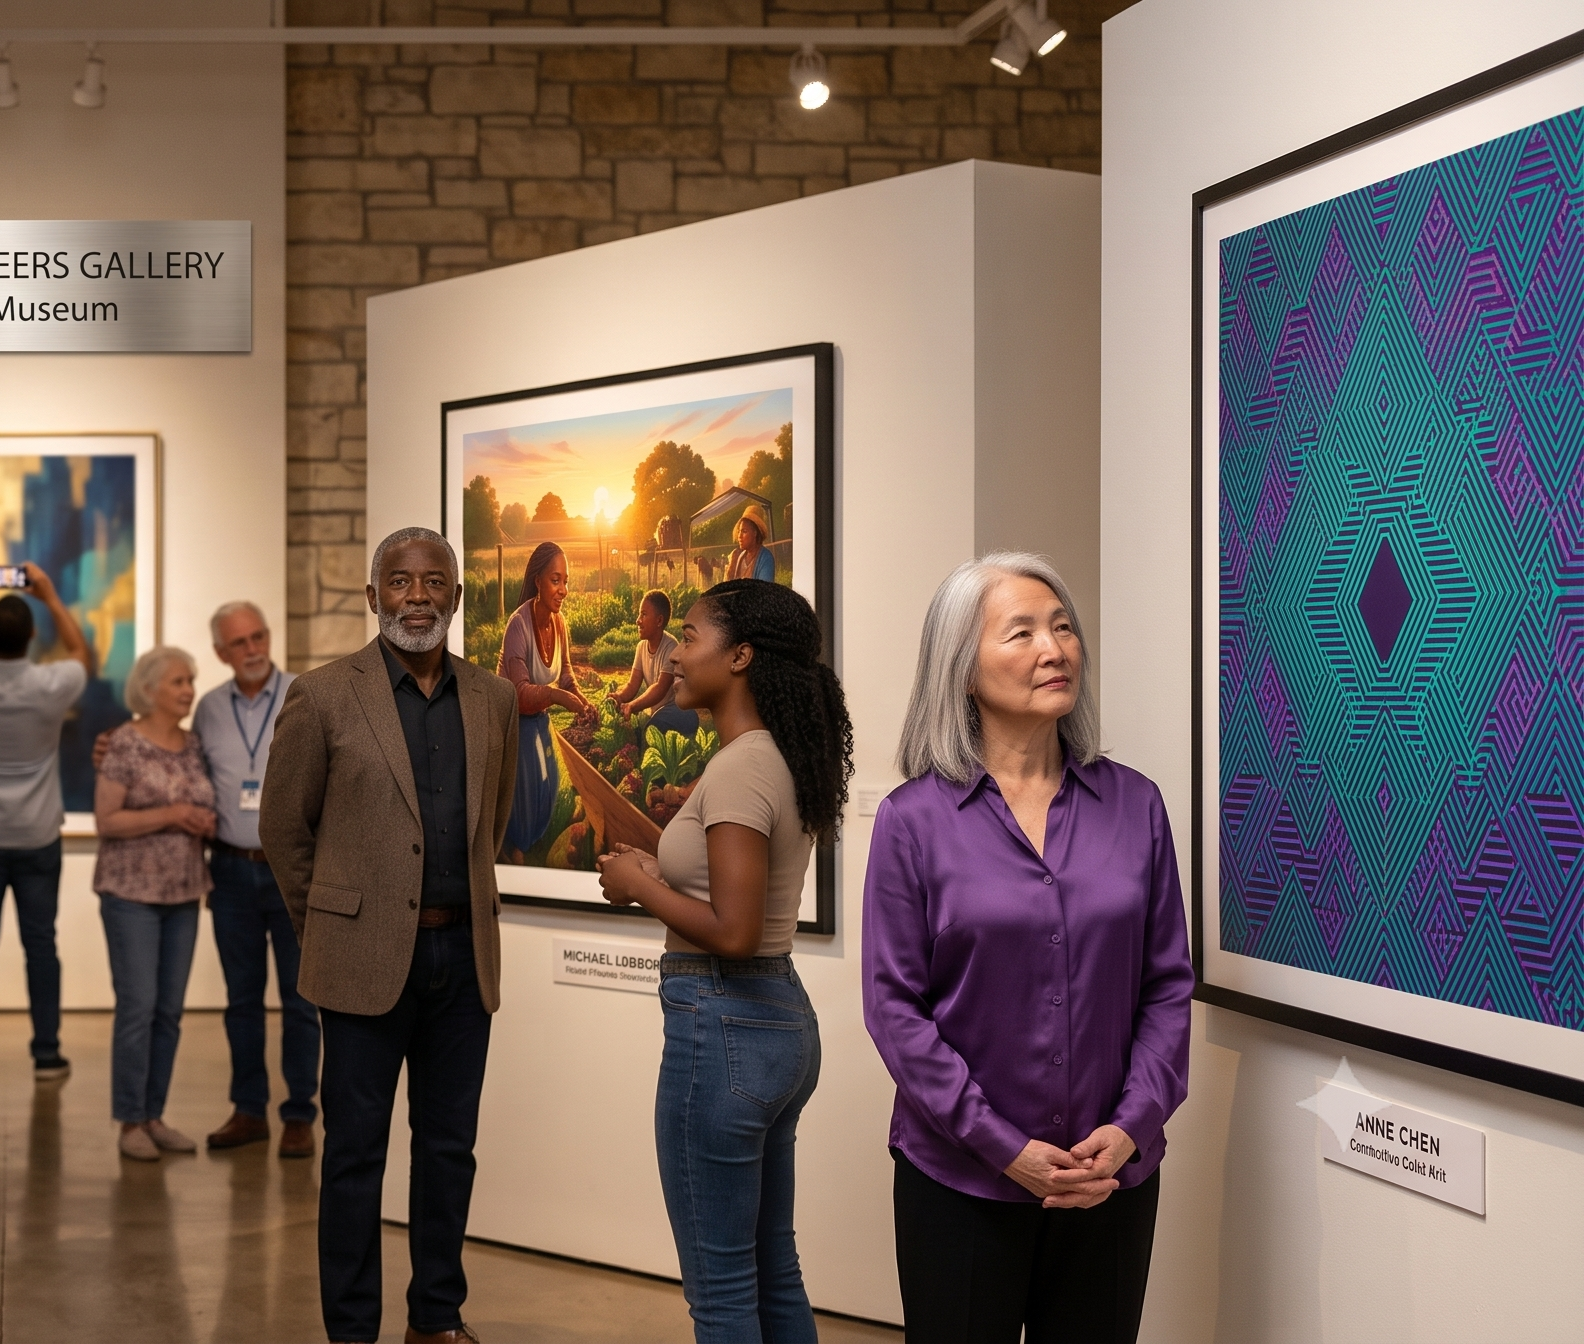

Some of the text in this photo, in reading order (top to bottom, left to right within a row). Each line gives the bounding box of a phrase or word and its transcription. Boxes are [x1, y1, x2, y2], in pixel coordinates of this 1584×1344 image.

[79, 251, 224, 279] GALLERY
[563, 949, 613, 966] MICHAEL
[1355, 1111, 1440, 1157] ANNE CHEN
